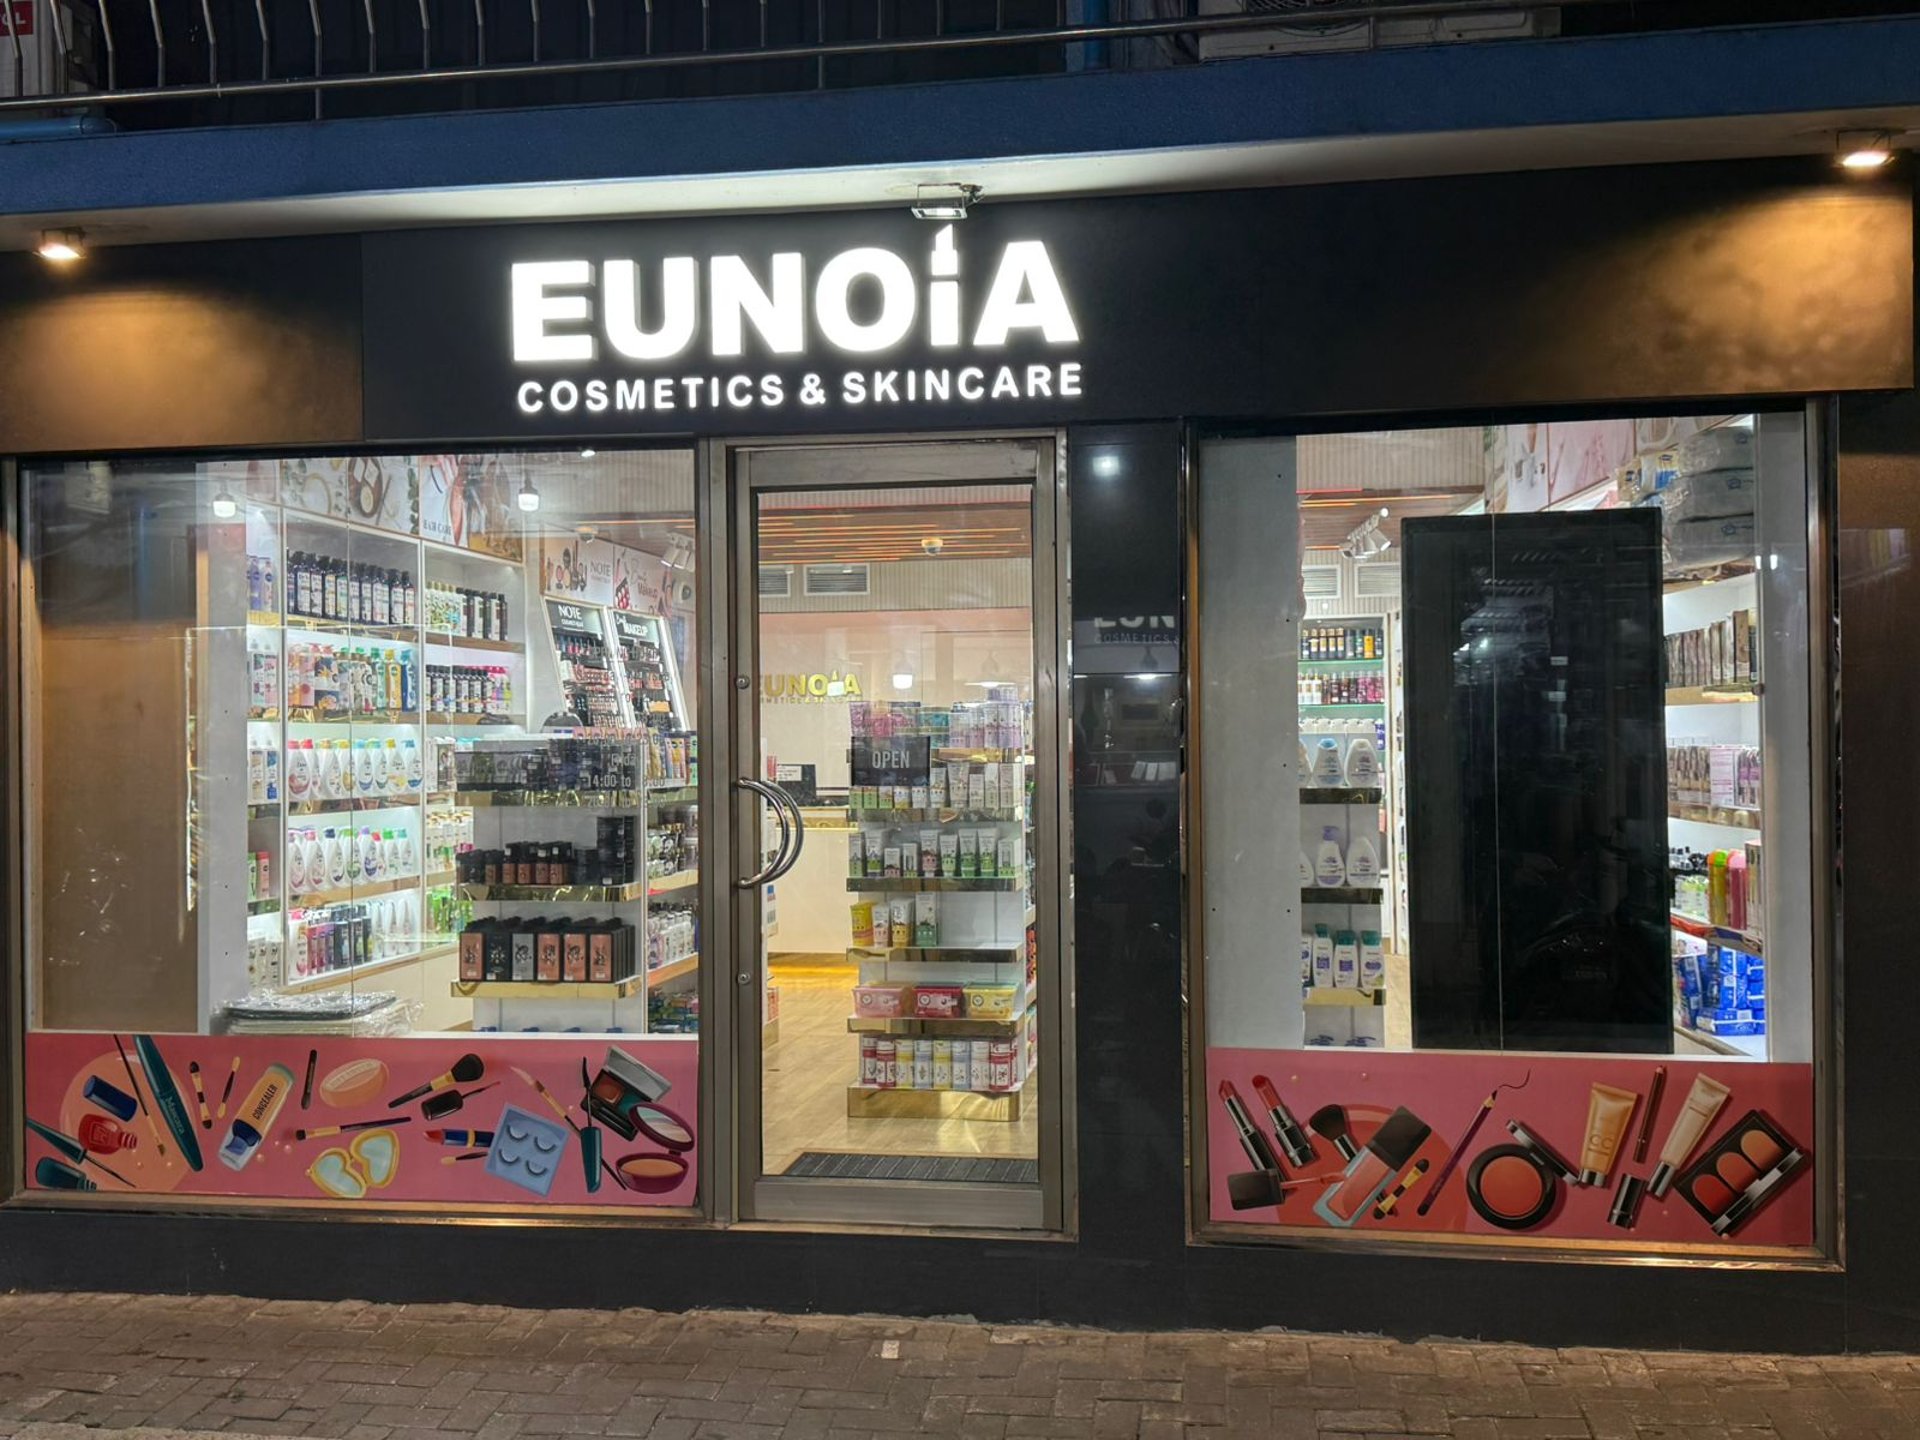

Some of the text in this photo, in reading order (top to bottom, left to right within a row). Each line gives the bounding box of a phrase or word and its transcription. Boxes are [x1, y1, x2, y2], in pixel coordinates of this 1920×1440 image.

[517, 363, 1083, 413] COSMETICS & SKINCARE
[558, 604, 582, 620] NOTE
[871, 750, 910, 769] OPEN
[252, 1083, 279, 1121] CONCEALER
[1590, 1133, 1614, 1150] CC
